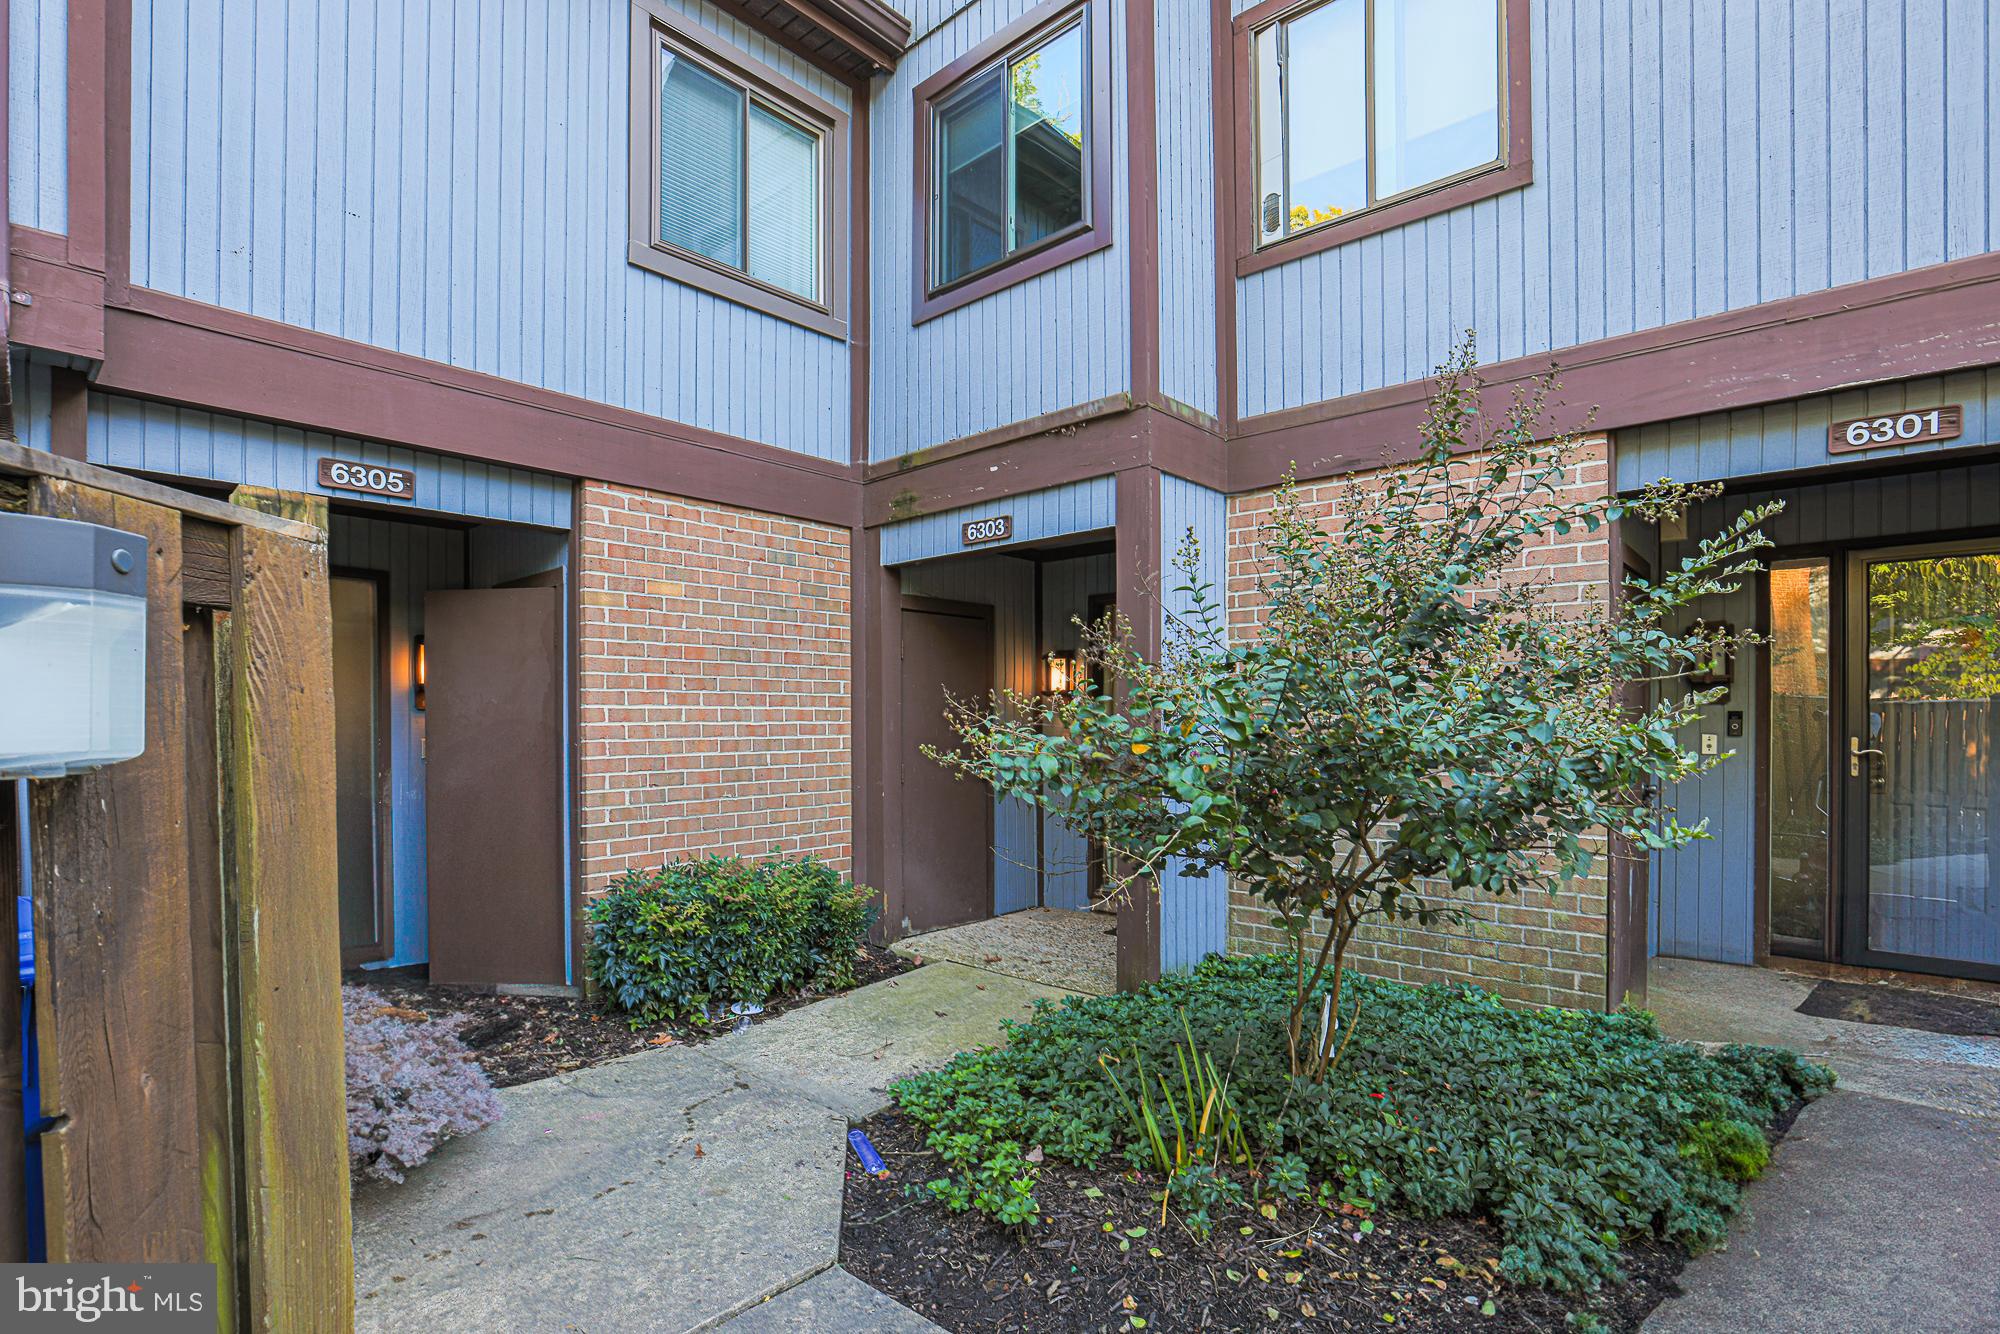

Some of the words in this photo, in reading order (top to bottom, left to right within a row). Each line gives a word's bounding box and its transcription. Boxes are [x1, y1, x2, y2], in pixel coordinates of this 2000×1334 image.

[1846, 410, 1940, 446] 6301
[330, 462, 404, 493] 6305
[967, 518, 1005, 540] 6303
